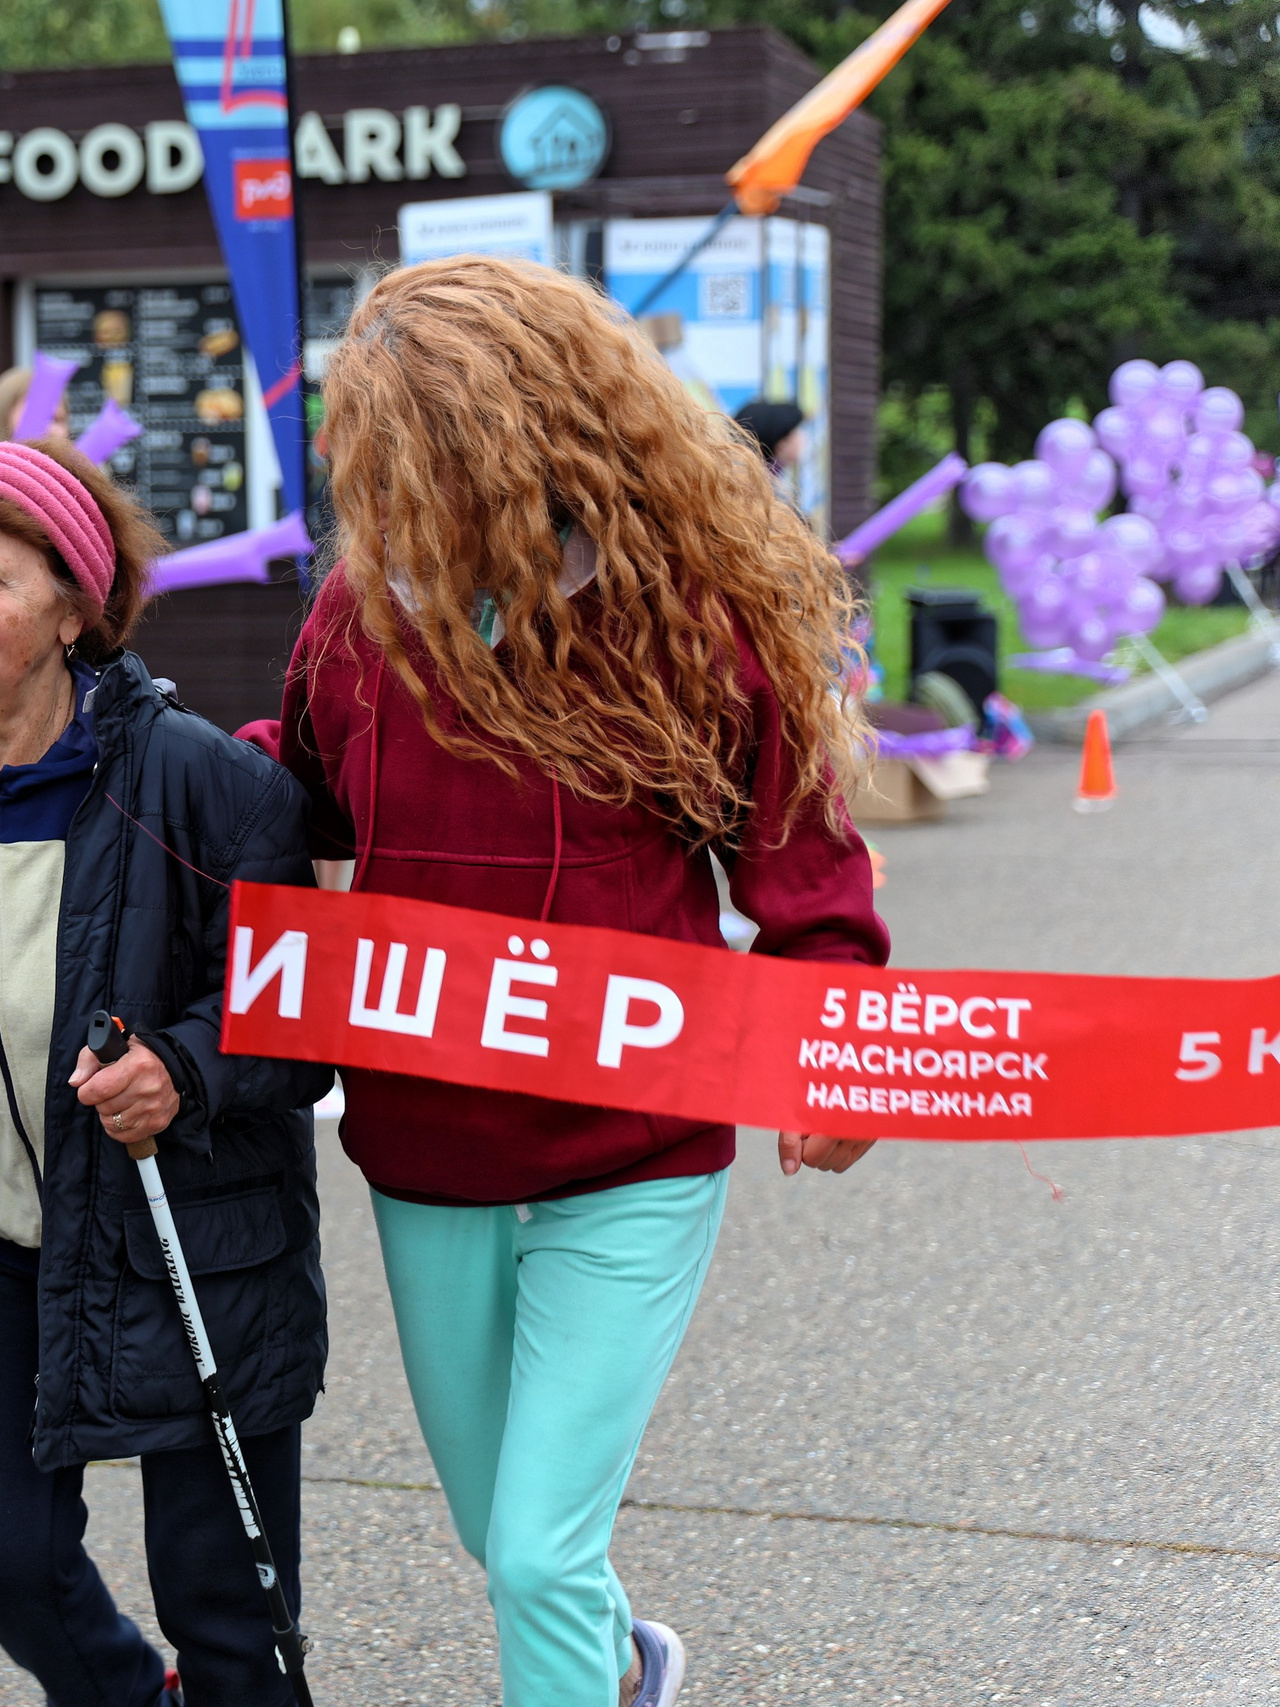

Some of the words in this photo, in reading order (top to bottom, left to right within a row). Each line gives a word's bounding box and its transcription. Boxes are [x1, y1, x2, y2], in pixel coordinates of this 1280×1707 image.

[295, 104, 467, 185] ARK
[228, 925, 686, 1069] ИШЁР
[820, 987, 847, 1029] 5
[856, 982, 1033, 1040] ВЁРСТ
[797, 1037, 1051, 1082] КРАСНОЯРСК
[1173, 1031, 1222, 1082] 5
[805, 1081, 1033, 1118] НАБЕРЕЖНАЯ
